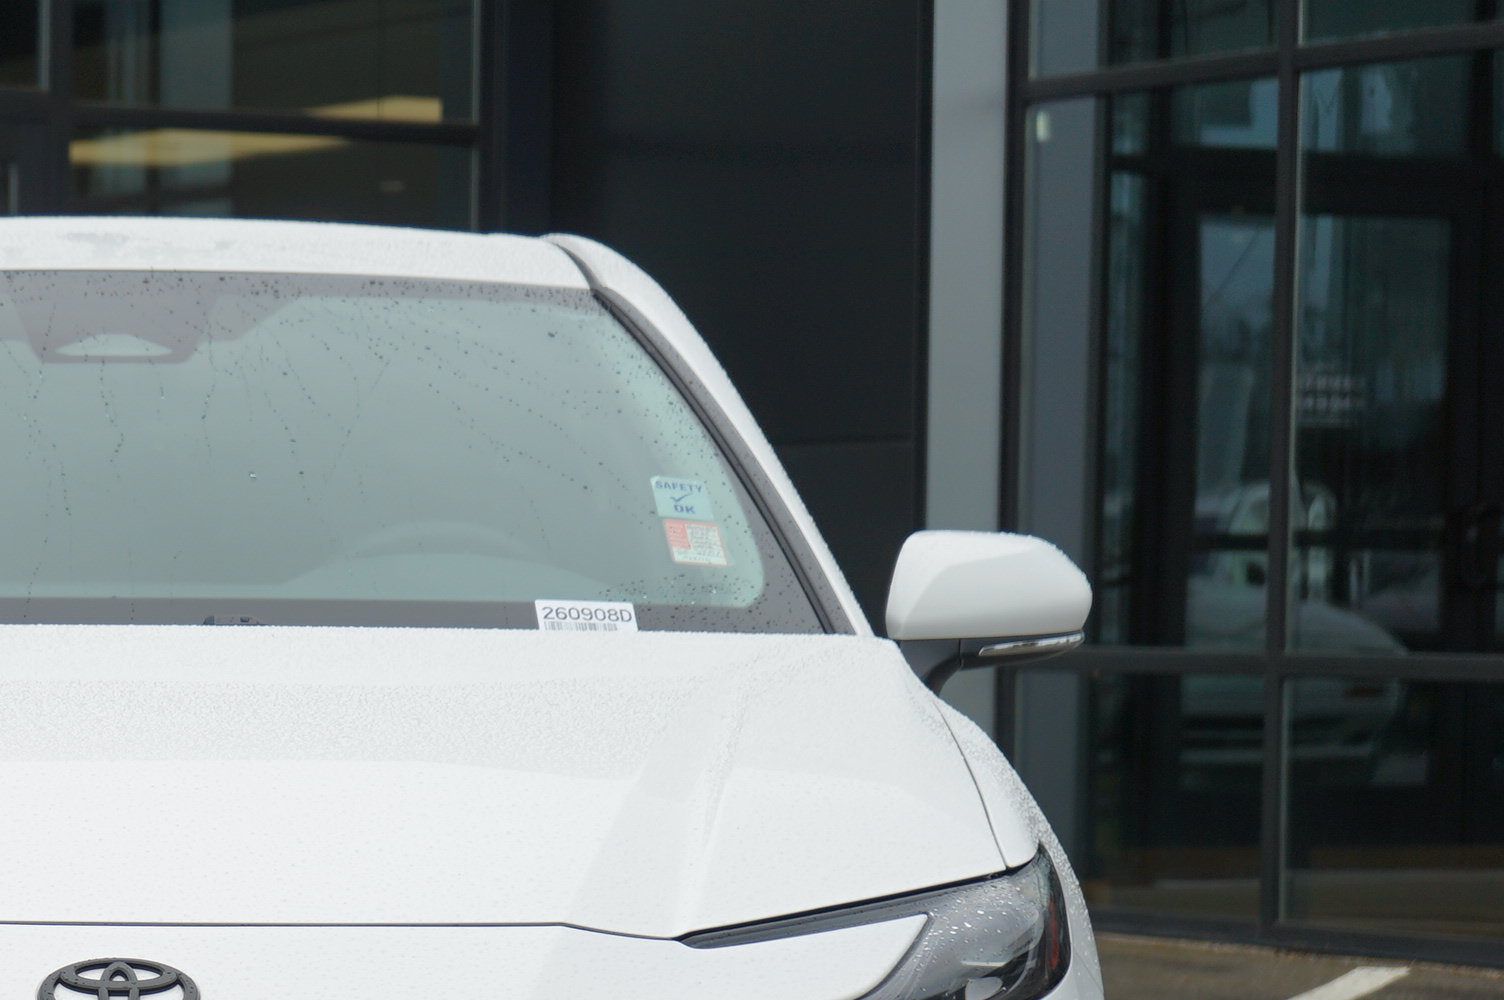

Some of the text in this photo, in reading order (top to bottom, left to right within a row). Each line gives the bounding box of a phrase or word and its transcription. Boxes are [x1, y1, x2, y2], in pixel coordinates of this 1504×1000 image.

[655, 480, 702, 493] SAFETY
[674, 504, 695, 514] OK
[542, 606, 632, 622] 260908D
